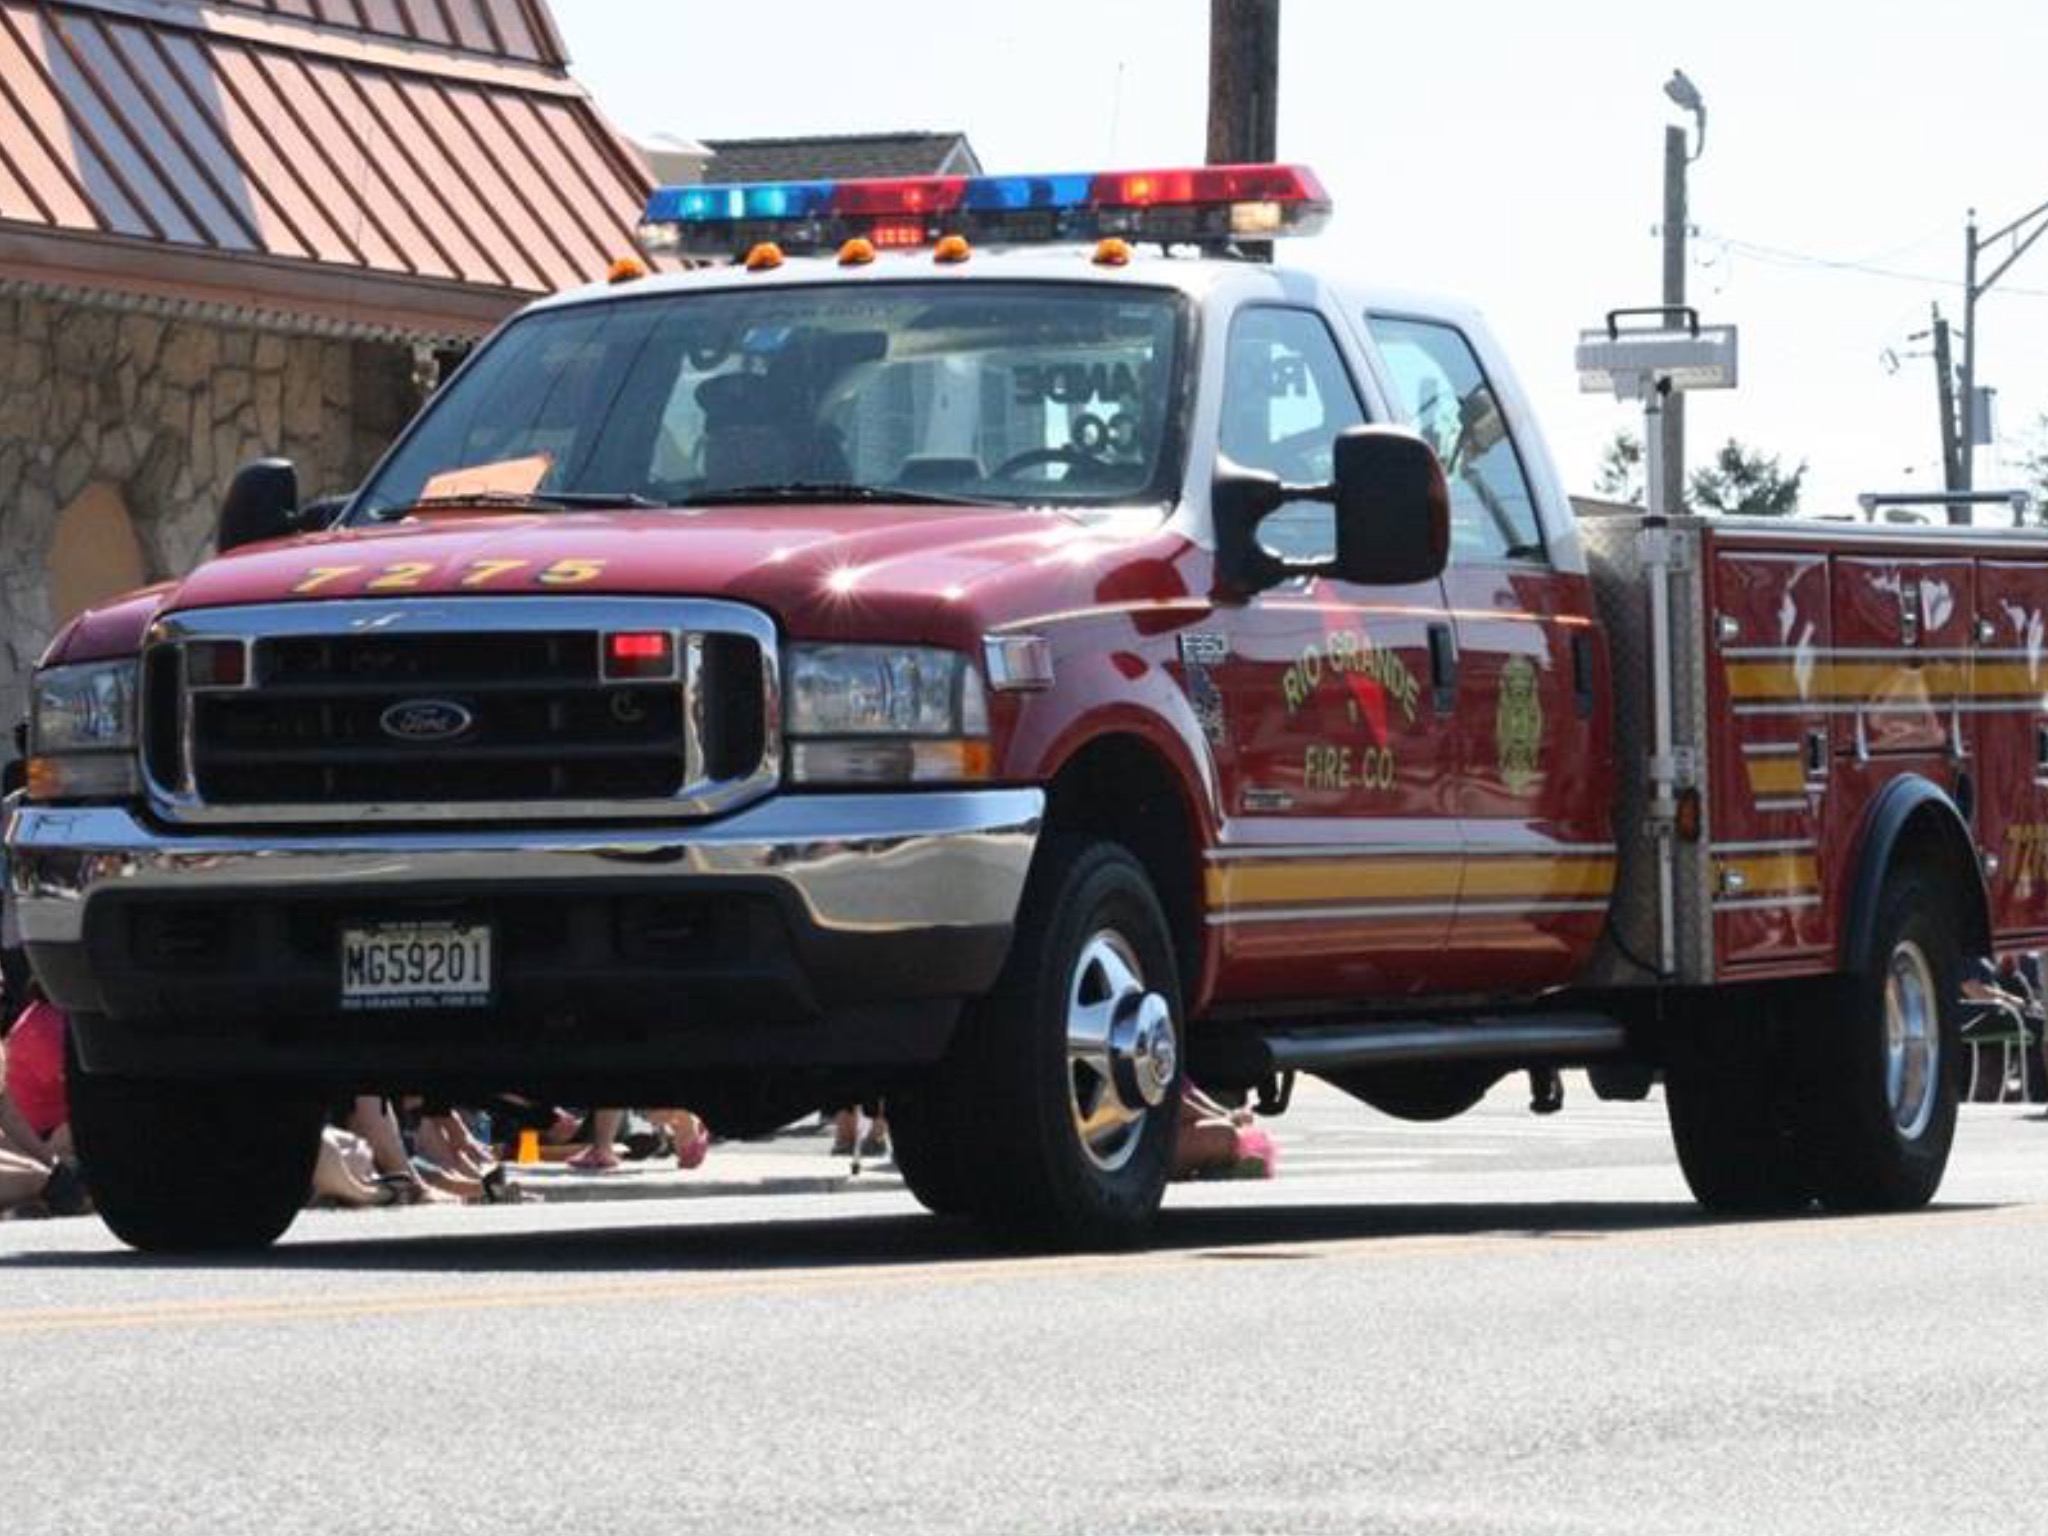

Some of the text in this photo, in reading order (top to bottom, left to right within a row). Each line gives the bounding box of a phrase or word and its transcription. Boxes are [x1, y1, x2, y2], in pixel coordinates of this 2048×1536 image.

[291, 558, 607, 593] 7275
[1283, 643, 1320, 714] RIO
[1327, 631, 1420, 723] GRANDE
[399, 707, 449, 731] Ford
[1305, 745, 1351, 790] FIRE
[346, 941, 482, 986] MG59201
